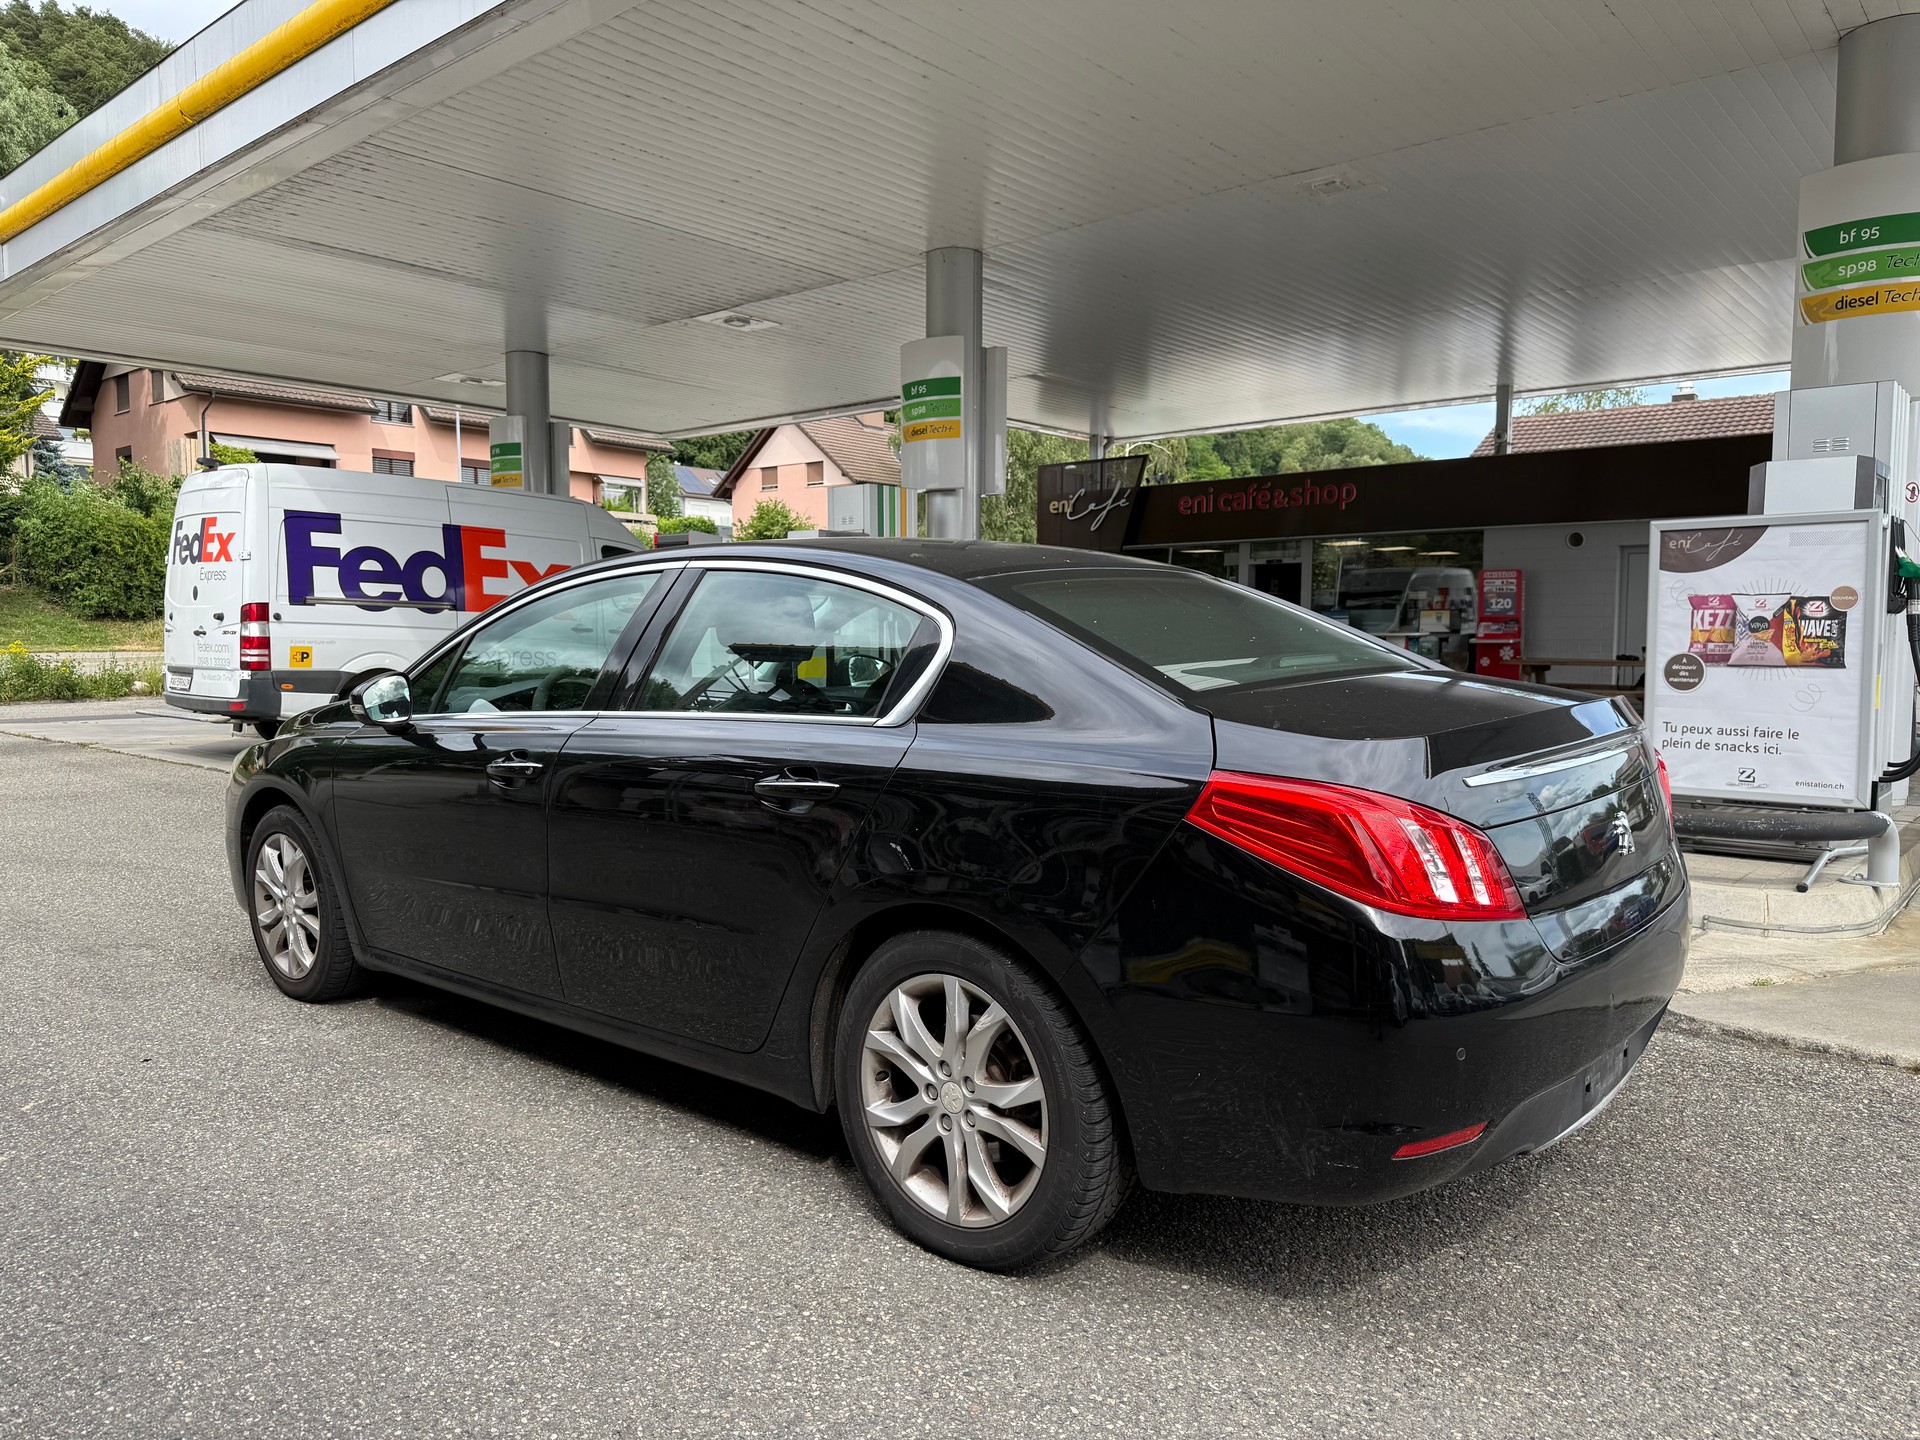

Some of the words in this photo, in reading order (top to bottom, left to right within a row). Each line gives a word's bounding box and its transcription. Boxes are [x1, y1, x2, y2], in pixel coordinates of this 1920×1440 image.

[1840, 228, 1857, 244] bf
[1860, 226, 1880, 241] 95
[1838, 260, 1877, 278] sp98
[1835, 291, 1880, 310] diesel
[918, 385, 927, 394] 95
[1177, 486, 1214, 515] eni
[172, 516, 236, 565] FedEx
[1669, 536, 1691, 549] eni
[200, 567, 227, 583] Express
[1489, 598, 1512, 609] 120
[1692, 609, 1735, 630] KEZZ
[1749, 622, 1769, 631] vaya
[197, 640, 230, 653] fedex.com
[484, 649, 557, 671] xpress
[1662, 721, 1678, 733] Tu
[1681, 725, 1713, 736] peux
[1716, 726, 1749, 737] aussi
[1753, 726, 1783, 739] faire
[1788, 728, 1800, 740] le
[1662, 737, 1691, 750] plein
[1695, 739, 1711, 751] de
[1714, 742, 1759, 754] snacks
[1763, 743, 1782, 755] ici.
[1795, 780, 1845, 790] enistation.ch
